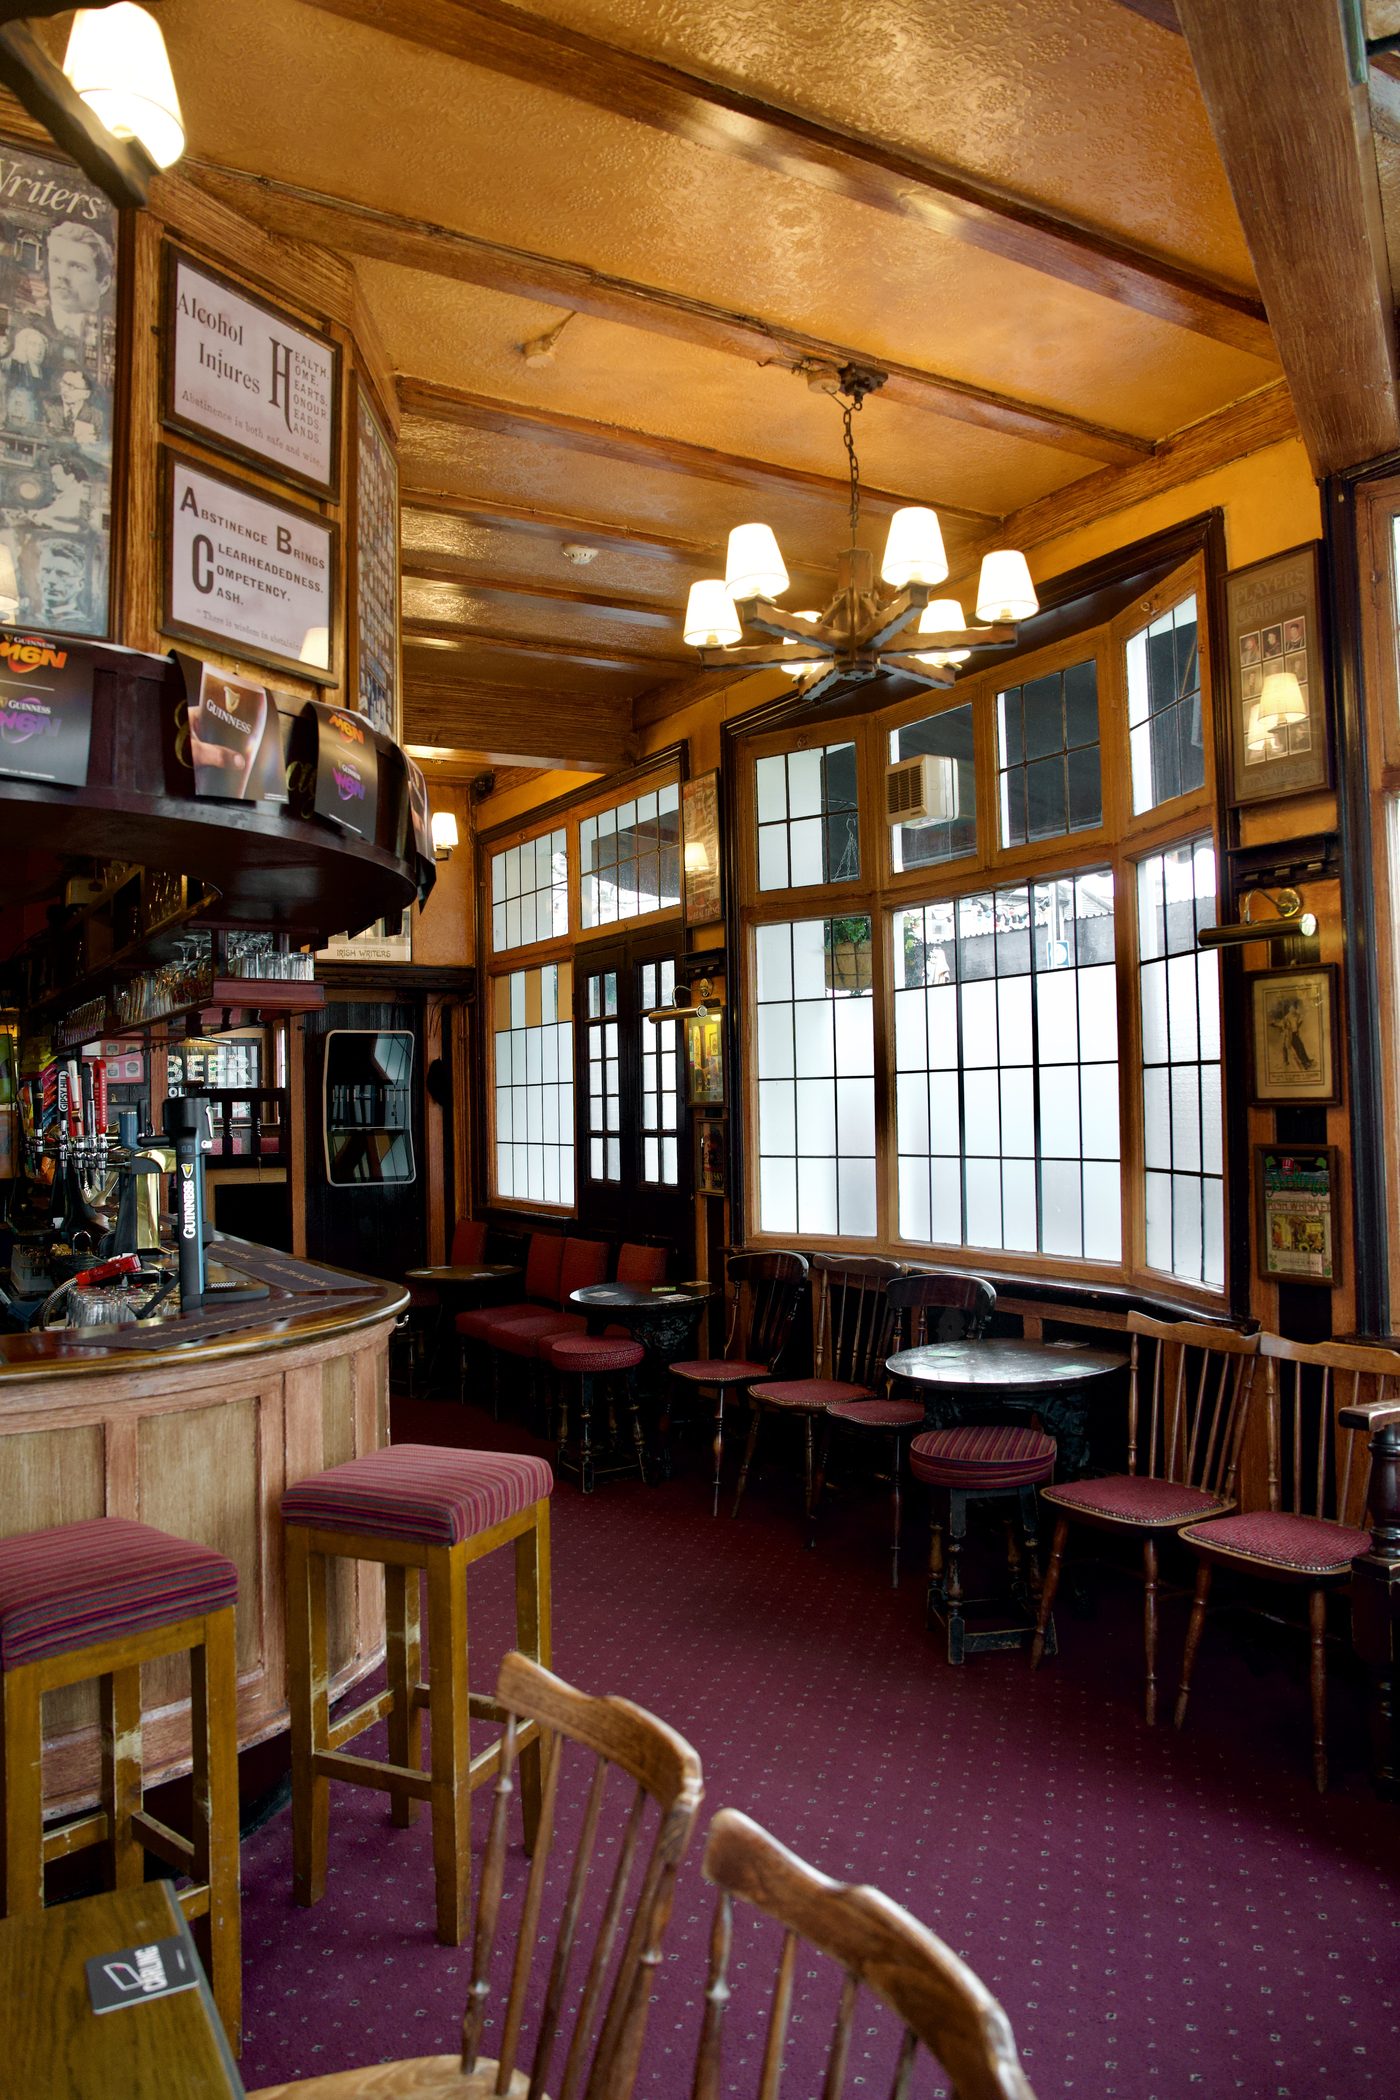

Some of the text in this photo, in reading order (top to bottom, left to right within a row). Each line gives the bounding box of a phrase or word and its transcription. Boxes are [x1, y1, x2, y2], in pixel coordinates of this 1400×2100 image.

[176, 293, 243, 346] Alcohol
[199, 342, 260, 394] Injures
[234, 416, 243, 428] is
[245, 421, 264, 439] both
[285, 444, 301, 457] and
[180, 486, 325, 570] ABSTINENCE BRINGS
[13, 636, 56, 650] GUINNESS
[8, 700, 52, 715] GUINNESS
[206, 699, 252, 735] GUINNESS
[336, 948, 391, 958] IRISH WRITERS
[166, 1054, 252, 1084] BEER
[60, 1088, 69, 1111] GIPSY
[183, 1180, 196, 1239] GUINNESS
